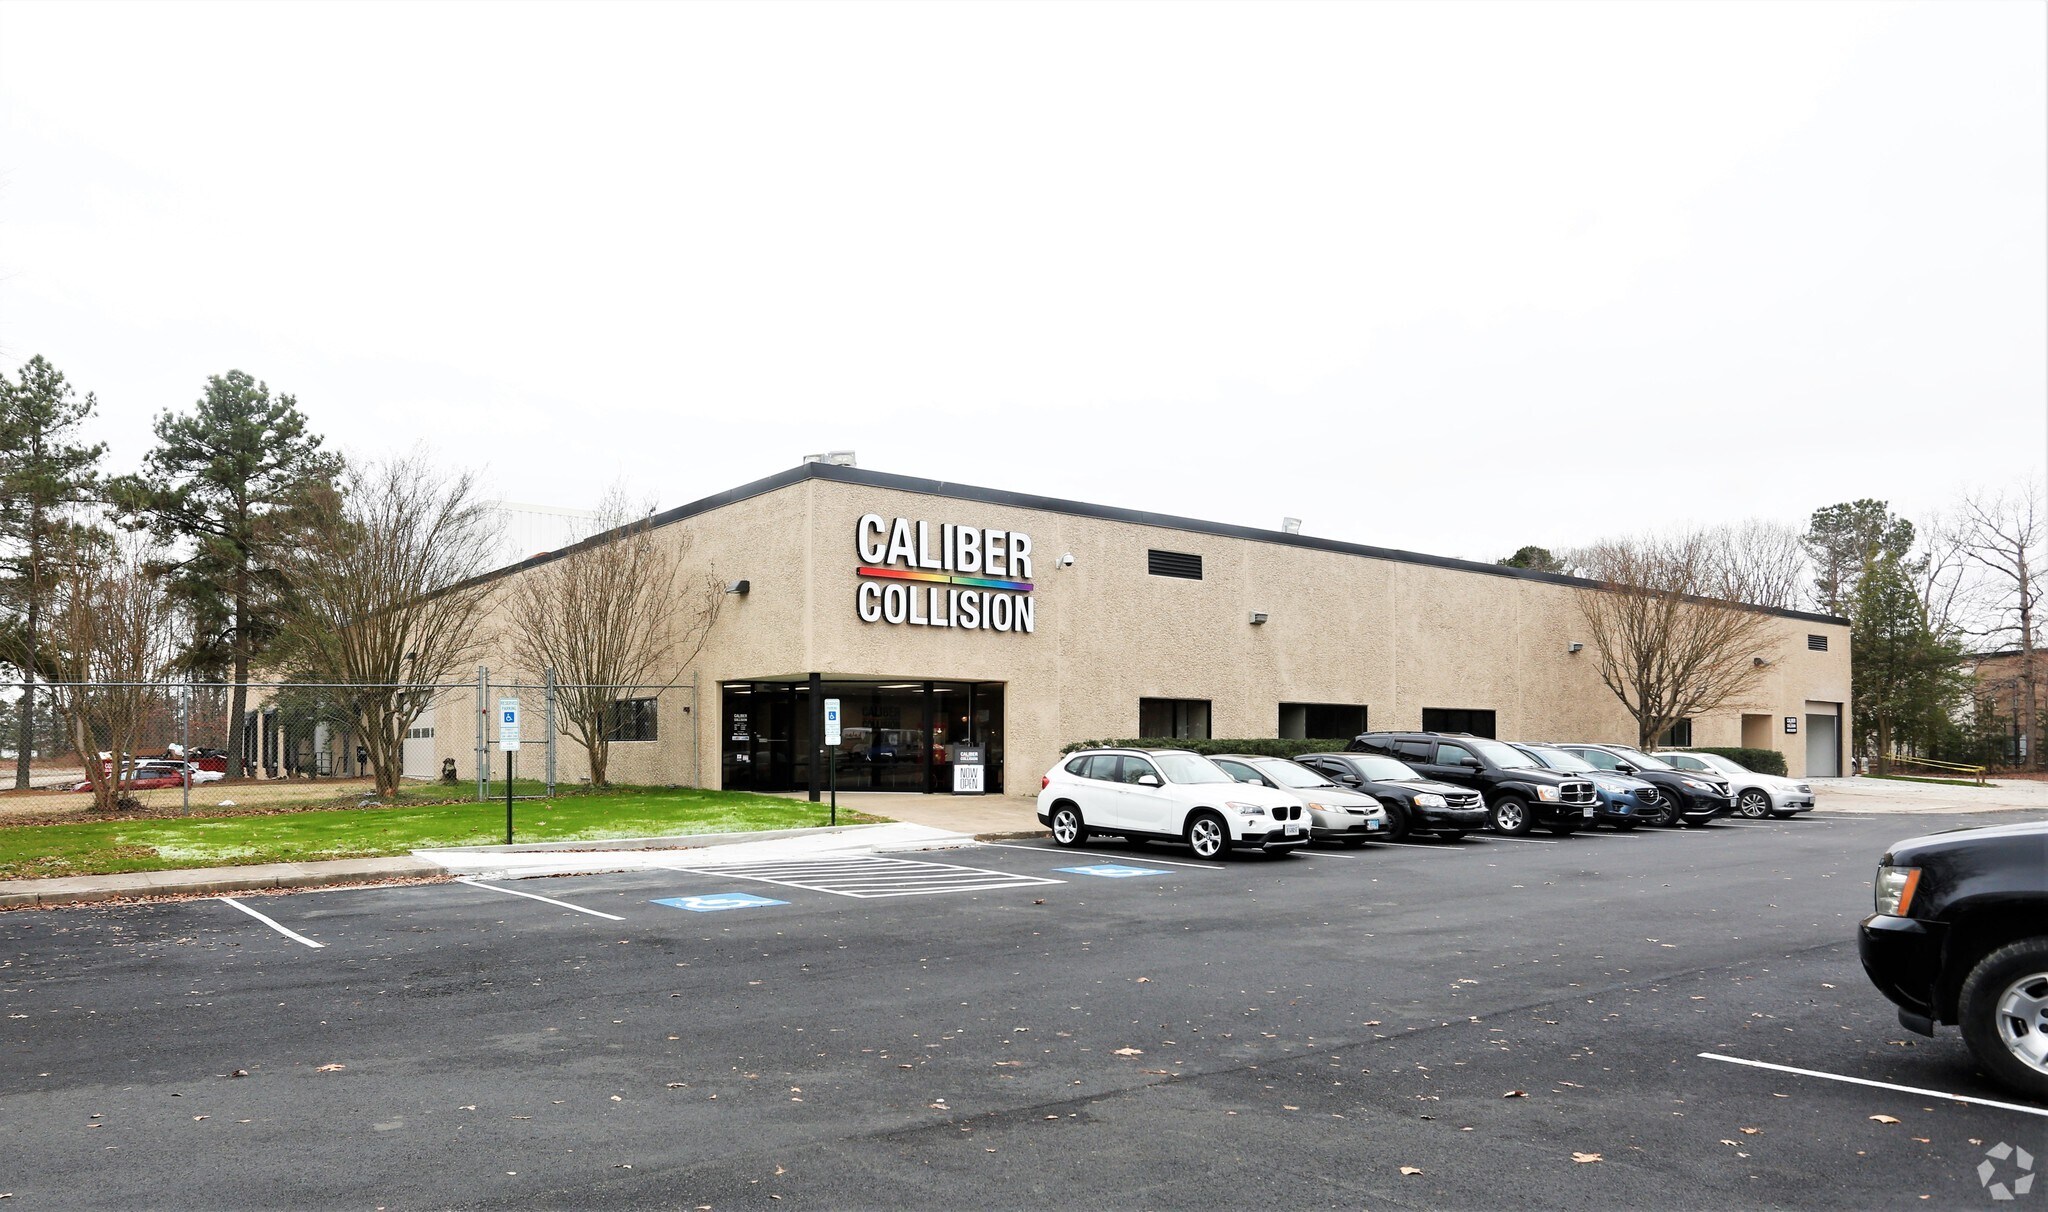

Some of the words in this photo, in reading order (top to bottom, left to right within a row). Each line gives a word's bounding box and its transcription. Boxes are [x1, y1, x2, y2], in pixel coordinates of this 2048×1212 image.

[856, 513, 1033, 579] CALIBER
[856, 581, 1035, 633] COLLISION
[960, 767, 978, 778] NOW
[960, 778, 978, 790] OPEN
